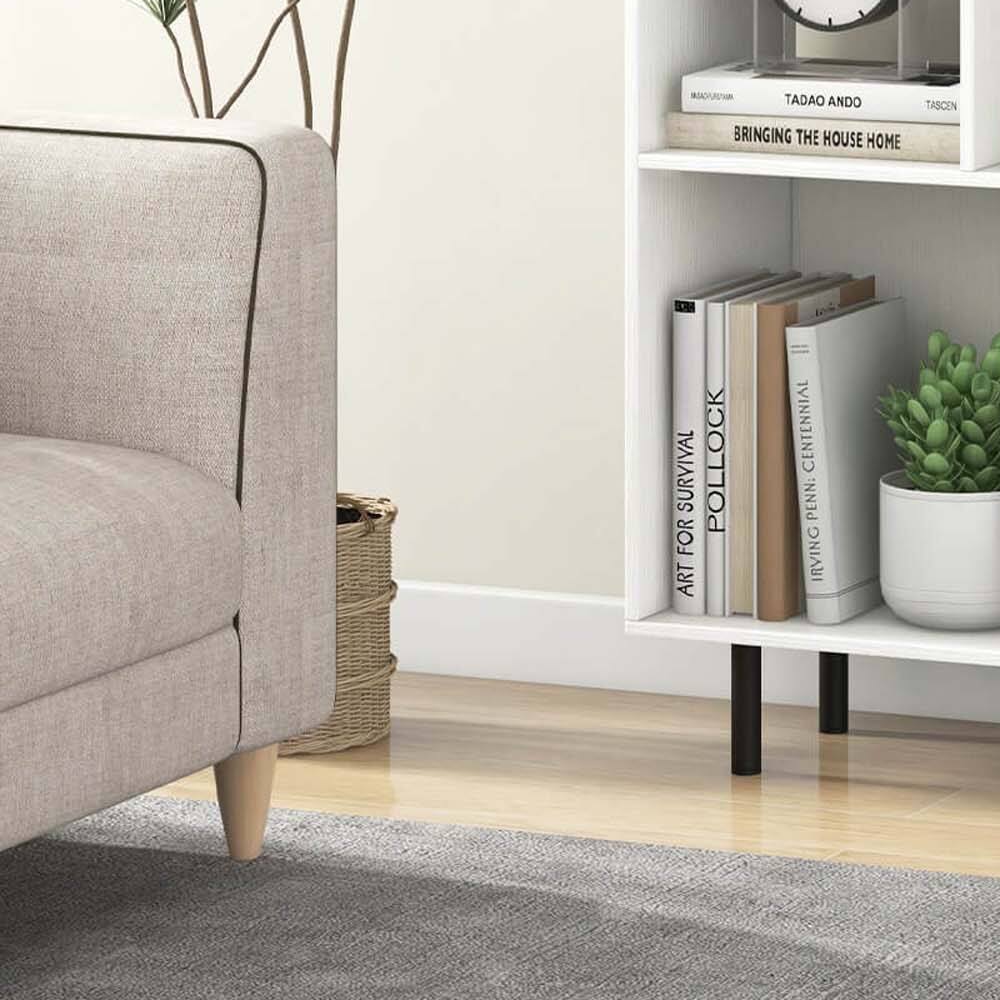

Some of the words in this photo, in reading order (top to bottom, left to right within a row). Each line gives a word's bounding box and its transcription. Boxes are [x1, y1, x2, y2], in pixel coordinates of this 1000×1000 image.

[784, 93, 826, 107] TADAO
[828, 95, 863, 109] ANDO
[734, 125, 792, 145] BRINGING
[796, 128, 819, 146] THE
[823, 130, 863, 149] HOUSE
[866, 132, 901, 150] HOME
[796, 379, 815, 472] CENTENNIAL
[676, 430, 695, 512] SURVIVAL
[707, 387, 726, 533] POLLOCK
[803, 478, 819, 521] PENN:
[676, 519, 694, 556] FOR
[807, 526, 824, 582] IRVING
[676, 562, 694, 597] ART
